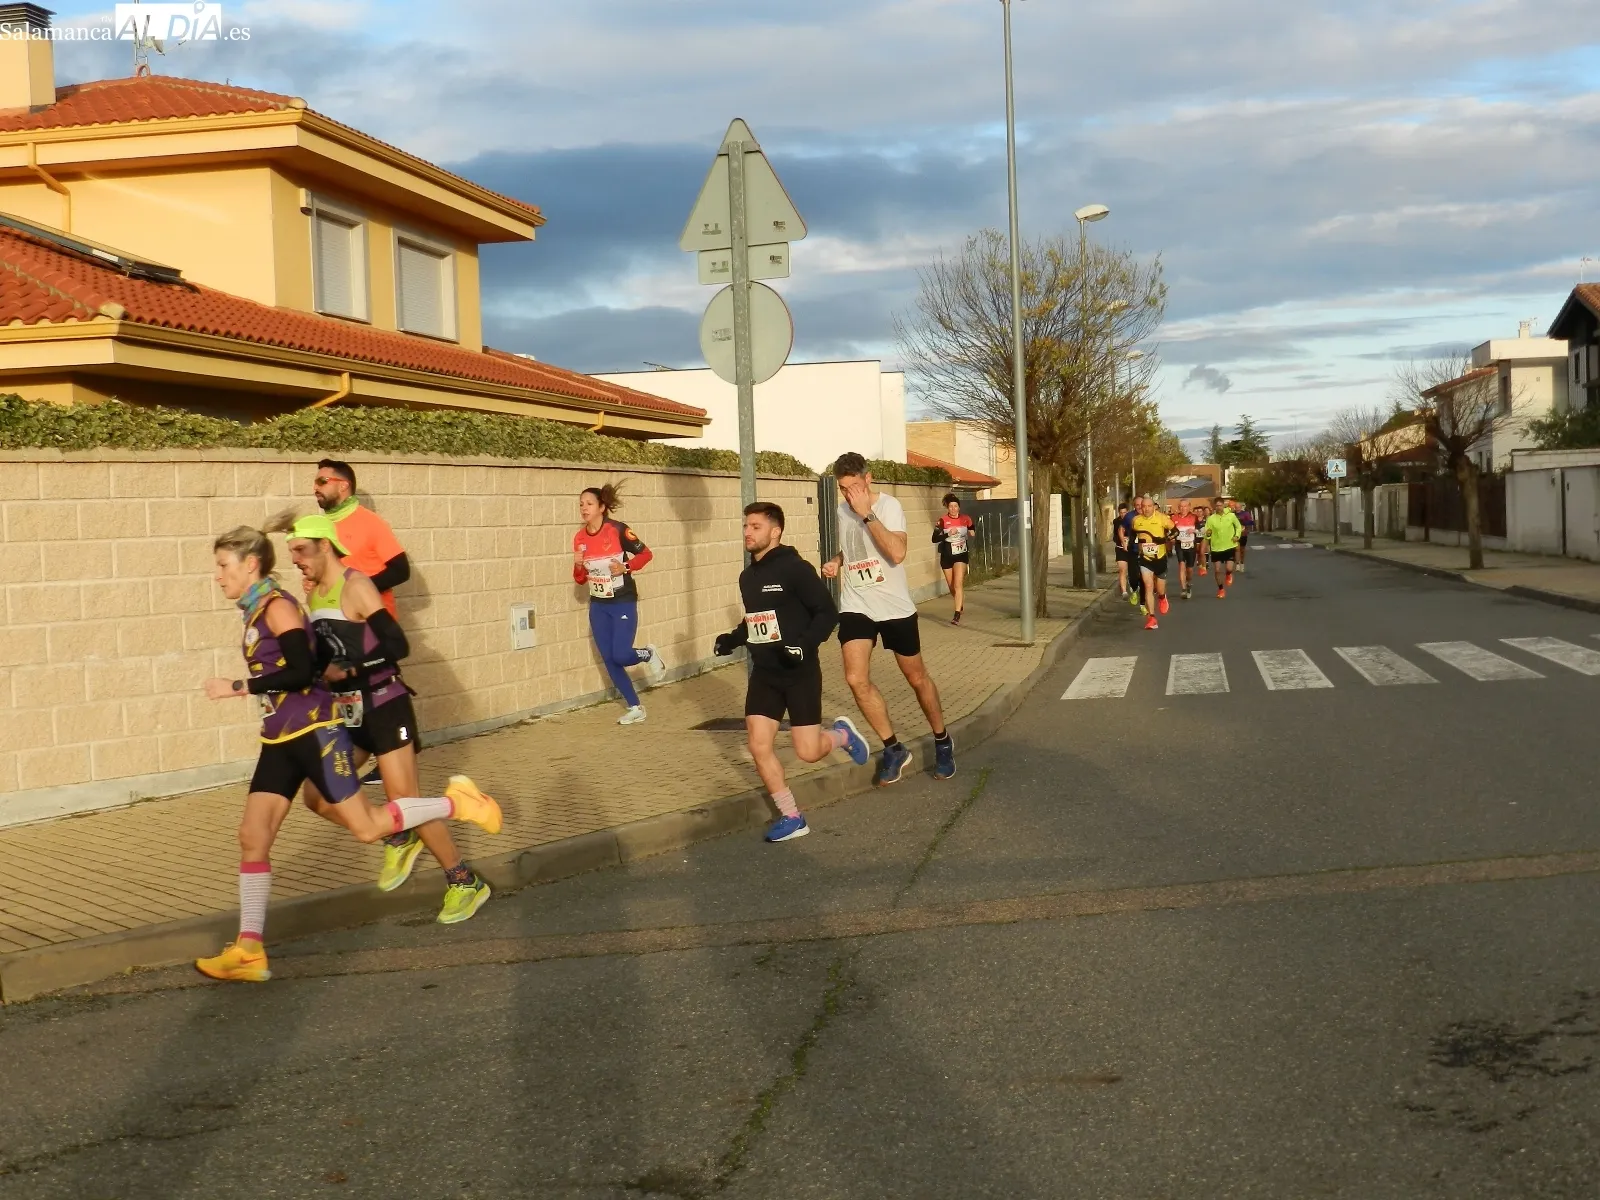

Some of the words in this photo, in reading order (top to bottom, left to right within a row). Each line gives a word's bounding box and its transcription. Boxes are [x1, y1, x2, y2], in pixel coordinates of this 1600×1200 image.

[857, 567, 873, 581] 11
[593, 582, 604, 592] 33
[753, 622, 768, 637] 10
[345, 704, 354, 719] 8
